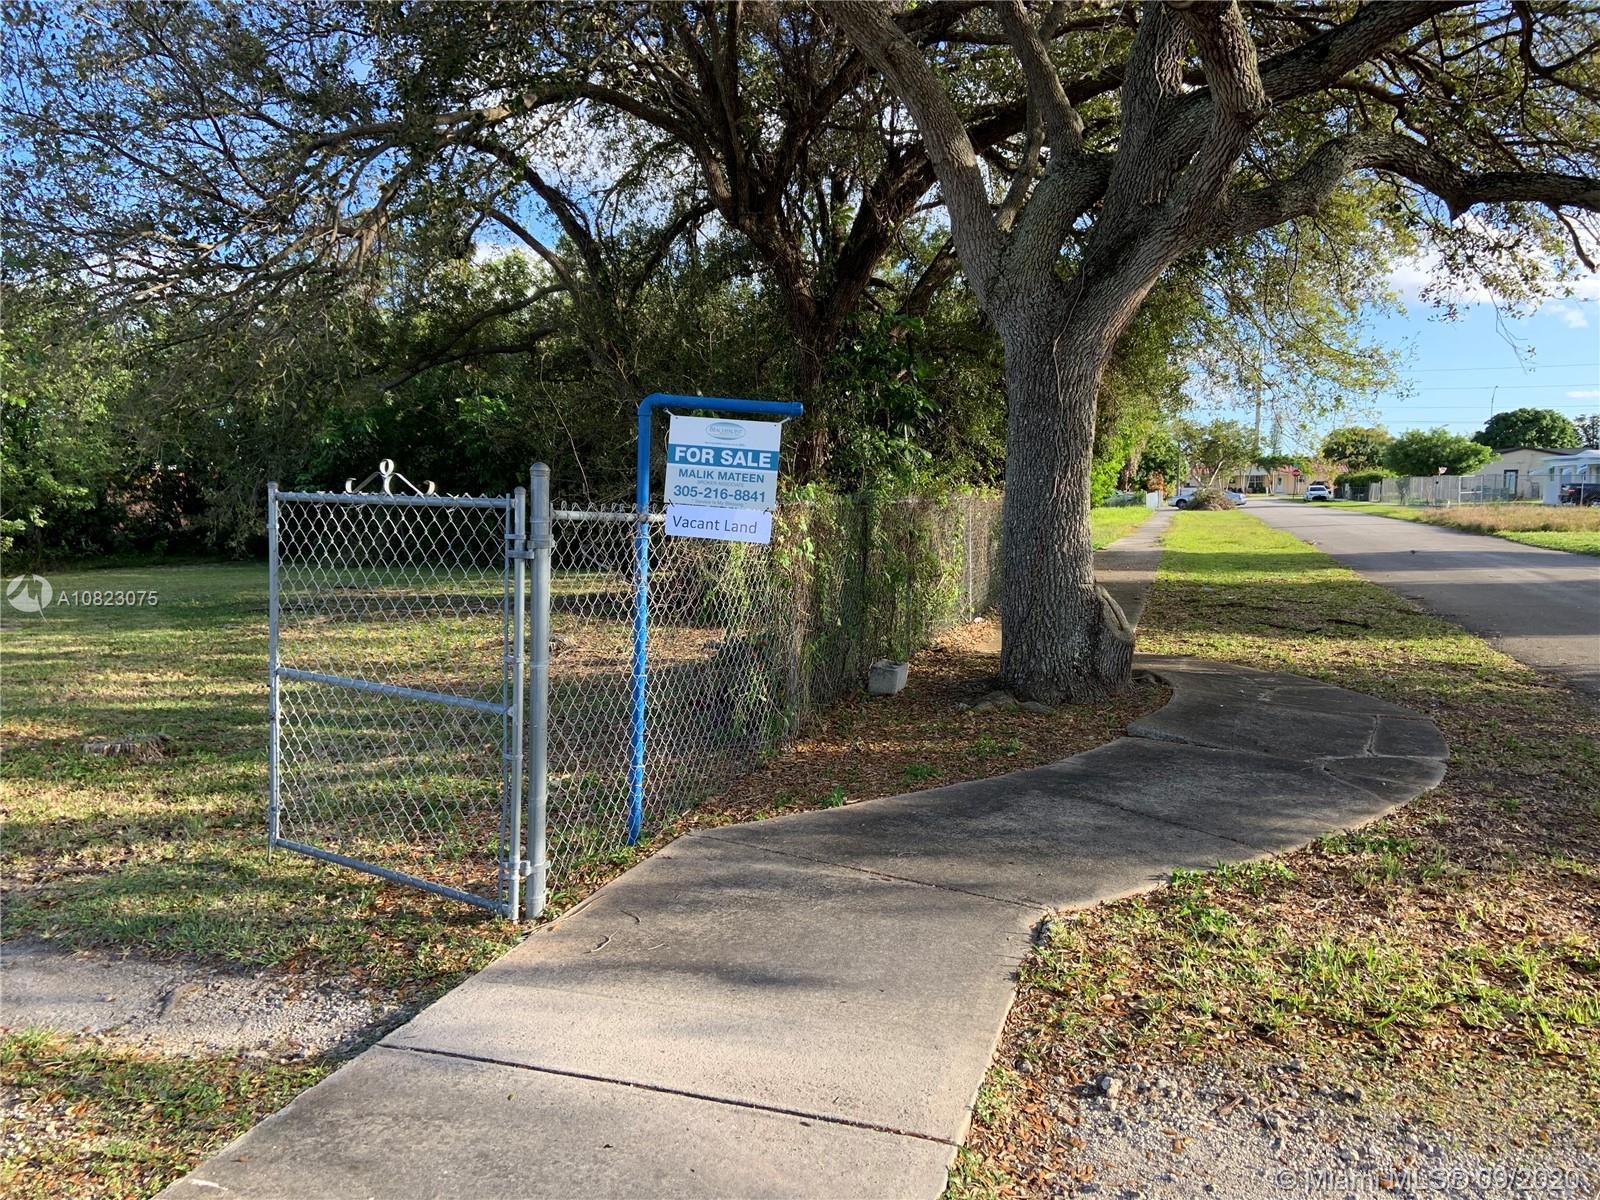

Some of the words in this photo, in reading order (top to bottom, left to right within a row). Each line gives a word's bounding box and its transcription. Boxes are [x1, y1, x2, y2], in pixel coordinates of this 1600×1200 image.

[675, 446, 714, 464] FOR
[720, 450, 772, 468] SALE
[678, 468, 714, 480] MALIK
[717, 471, 765, 483] MATEEN
[673, 485, 765, 502] 305-216-8841
[673, 515, 720, 531] Vacant
[724, 520, 758, 534] Land
